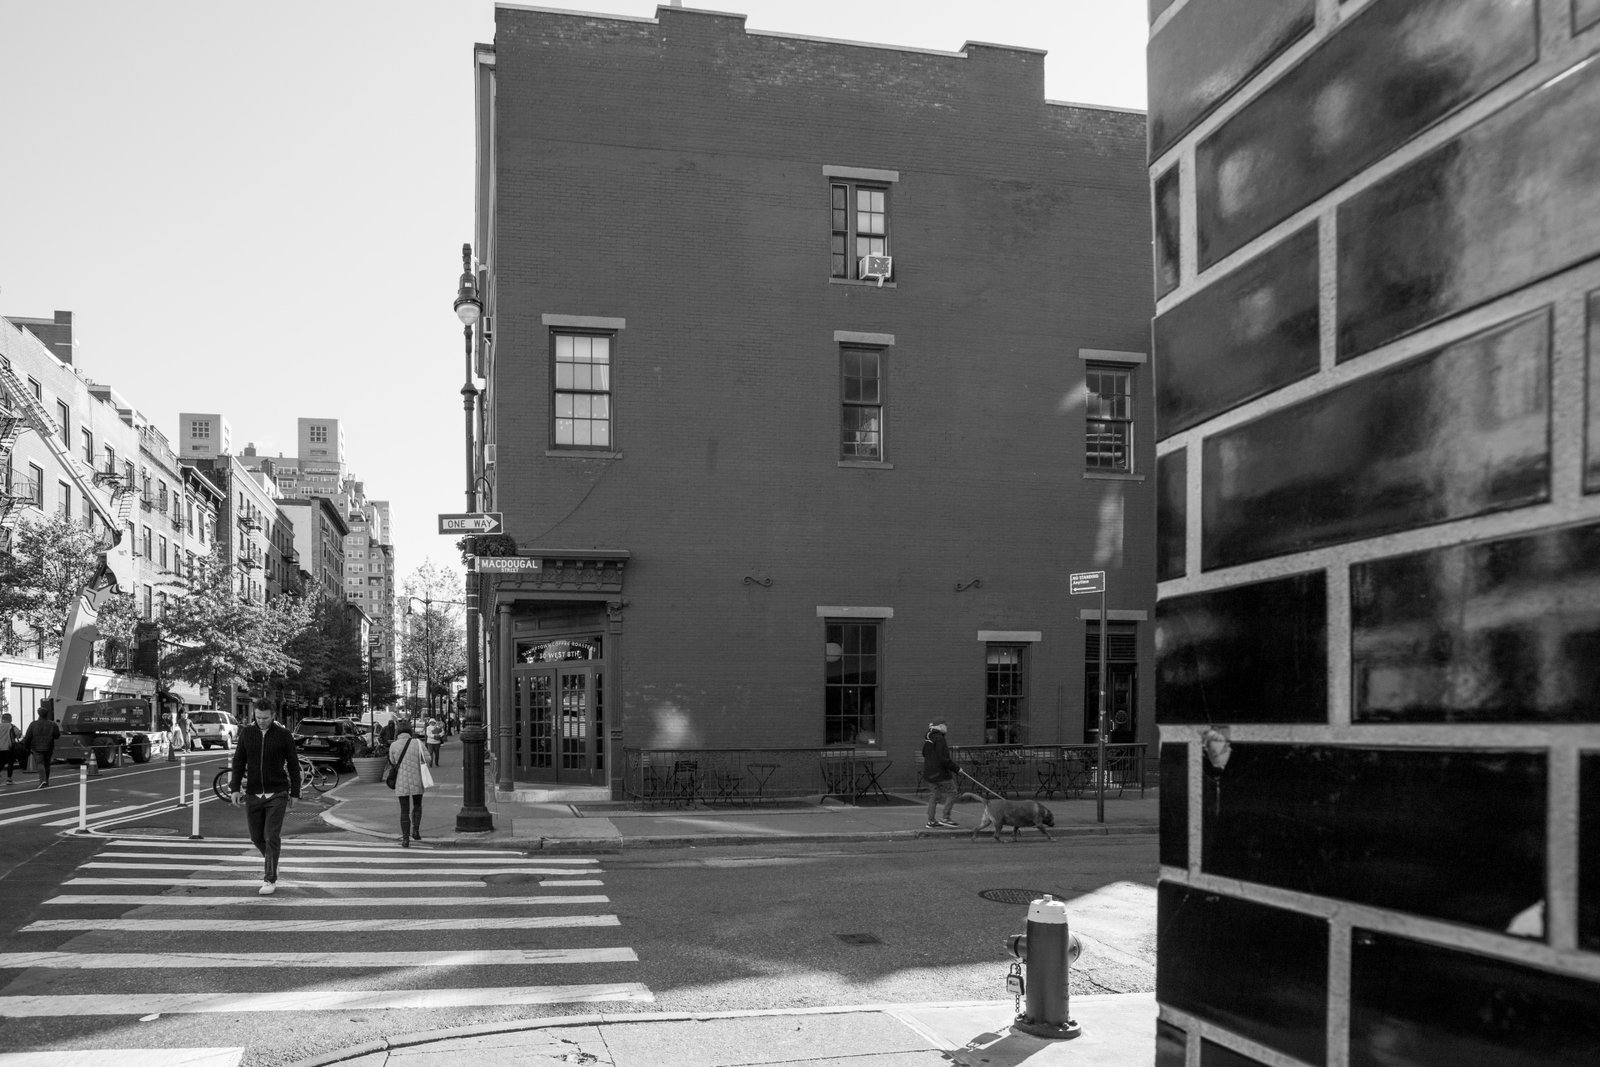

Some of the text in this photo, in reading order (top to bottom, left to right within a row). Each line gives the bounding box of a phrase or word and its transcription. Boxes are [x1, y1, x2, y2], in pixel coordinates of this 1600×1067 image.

[447, 519, 493, 528] ONE WAY
[481, 559, 538, 569] MACDOUGAL
[548, 651, 566, 659] WEST
